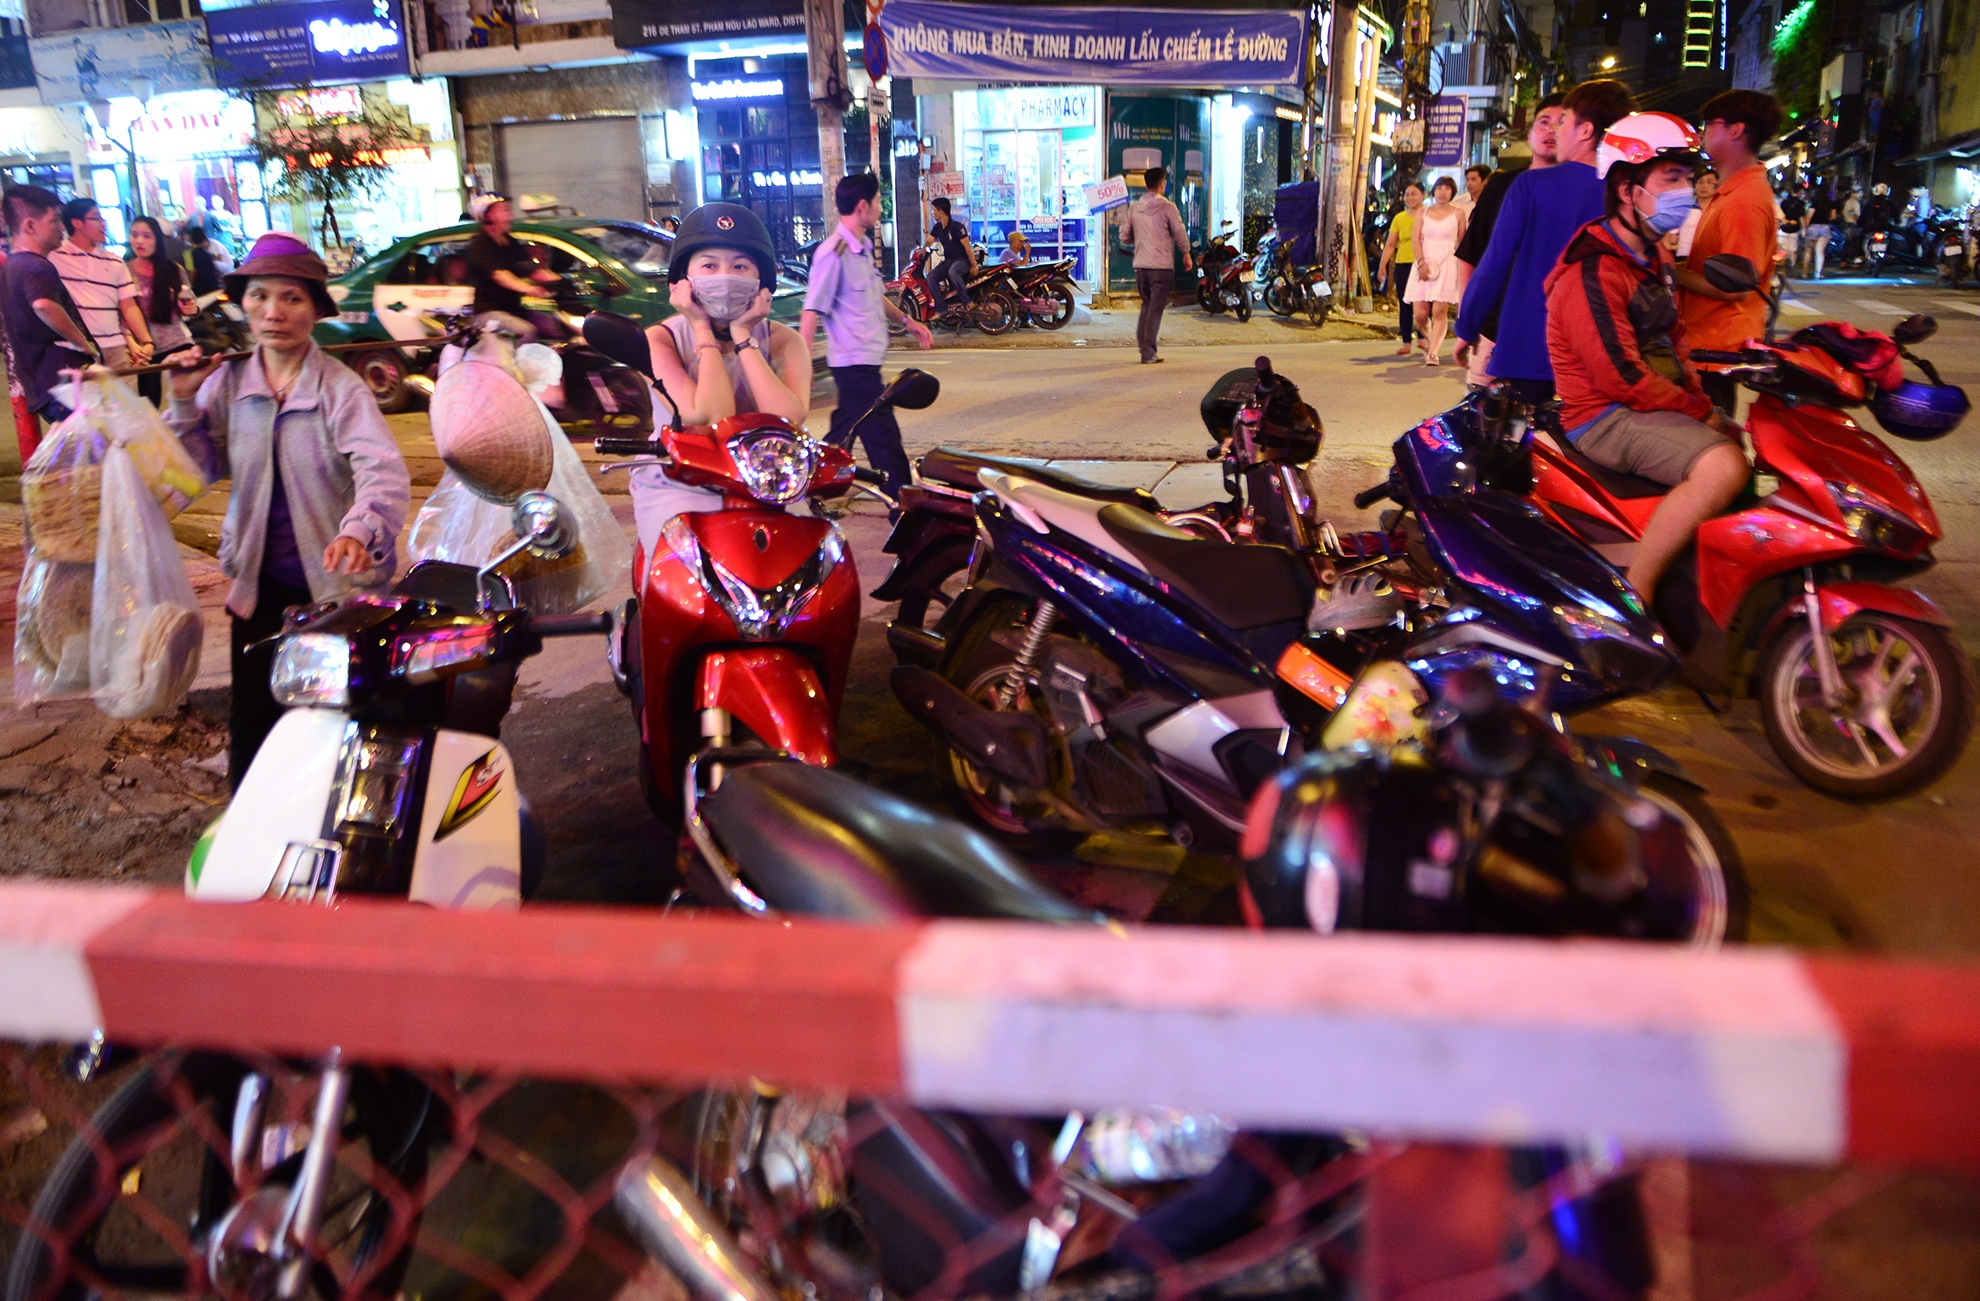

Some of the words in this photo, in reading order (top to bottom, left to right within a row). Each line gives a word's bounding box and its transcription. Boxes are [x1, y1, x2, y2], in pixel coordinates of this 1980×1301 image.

[642, 24, 657, 38] 216
[660, 24, 670, 36] DE
[670, 24, 690, 36] THAM
[691, 23, 702, 34] ST.
[704, 20, 725, 34] PHAM
[725, 18, 741, 32] NGU
[742, 18, 758, 30] LAO
[758, 15, 782, 30] WARD,
[893, 21, 948, 54] KHÔNG
[953, 30, 988, 56] MUA
[992, 26, 1028, 61] BÁN,
[1033, 34, 1070, 59] KINH
[1074, 35, 1126, 60] DOANH
[1130, 28, 1160, 61] LẤN
[1163, 28, 1211, 62] CHIẾM
[1215, 28, 1234, 61] LỀ
[1238, 32, 1288, 62] ĐƯỜNG
[1021, 96, 1087, 118] PHARMACY
[896, 140, 918, 157] 216
[930, 182, 948, 197] 50%
[1098, 183, 1124, 200] 50%
